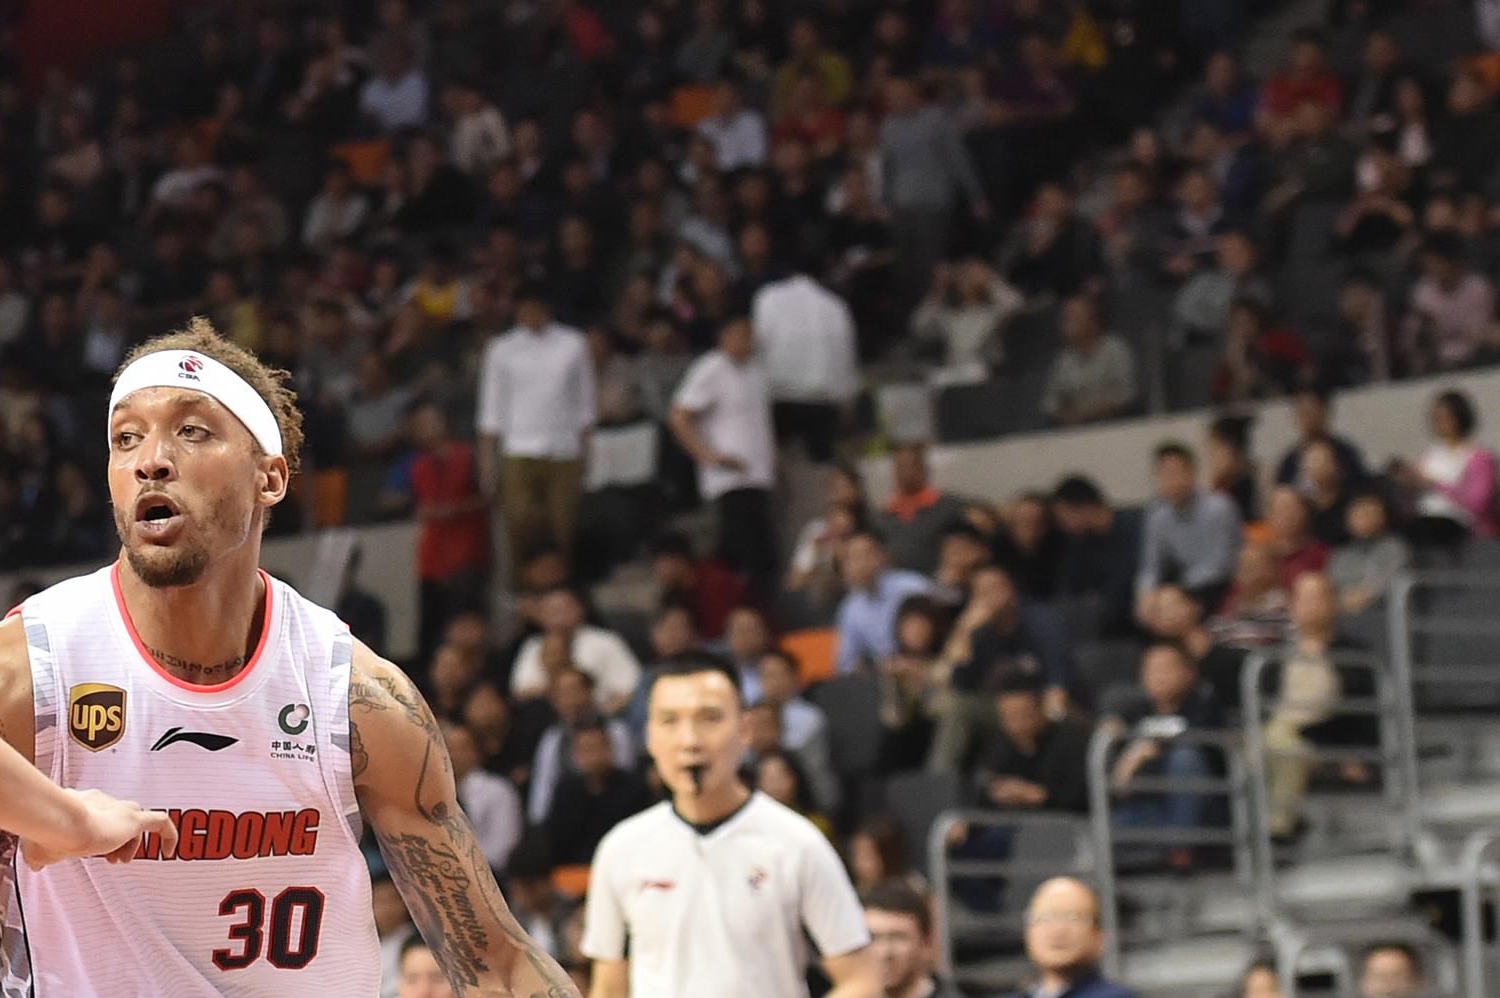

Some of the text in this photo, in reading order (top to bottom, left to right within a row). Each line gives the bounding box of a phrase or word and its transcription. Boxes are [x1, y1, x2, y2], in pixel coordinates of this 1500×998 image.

[73, 703, 122, 742] ups
[297, 753, 315, 762] LIFE
[212, 886, 326, 972] 30
